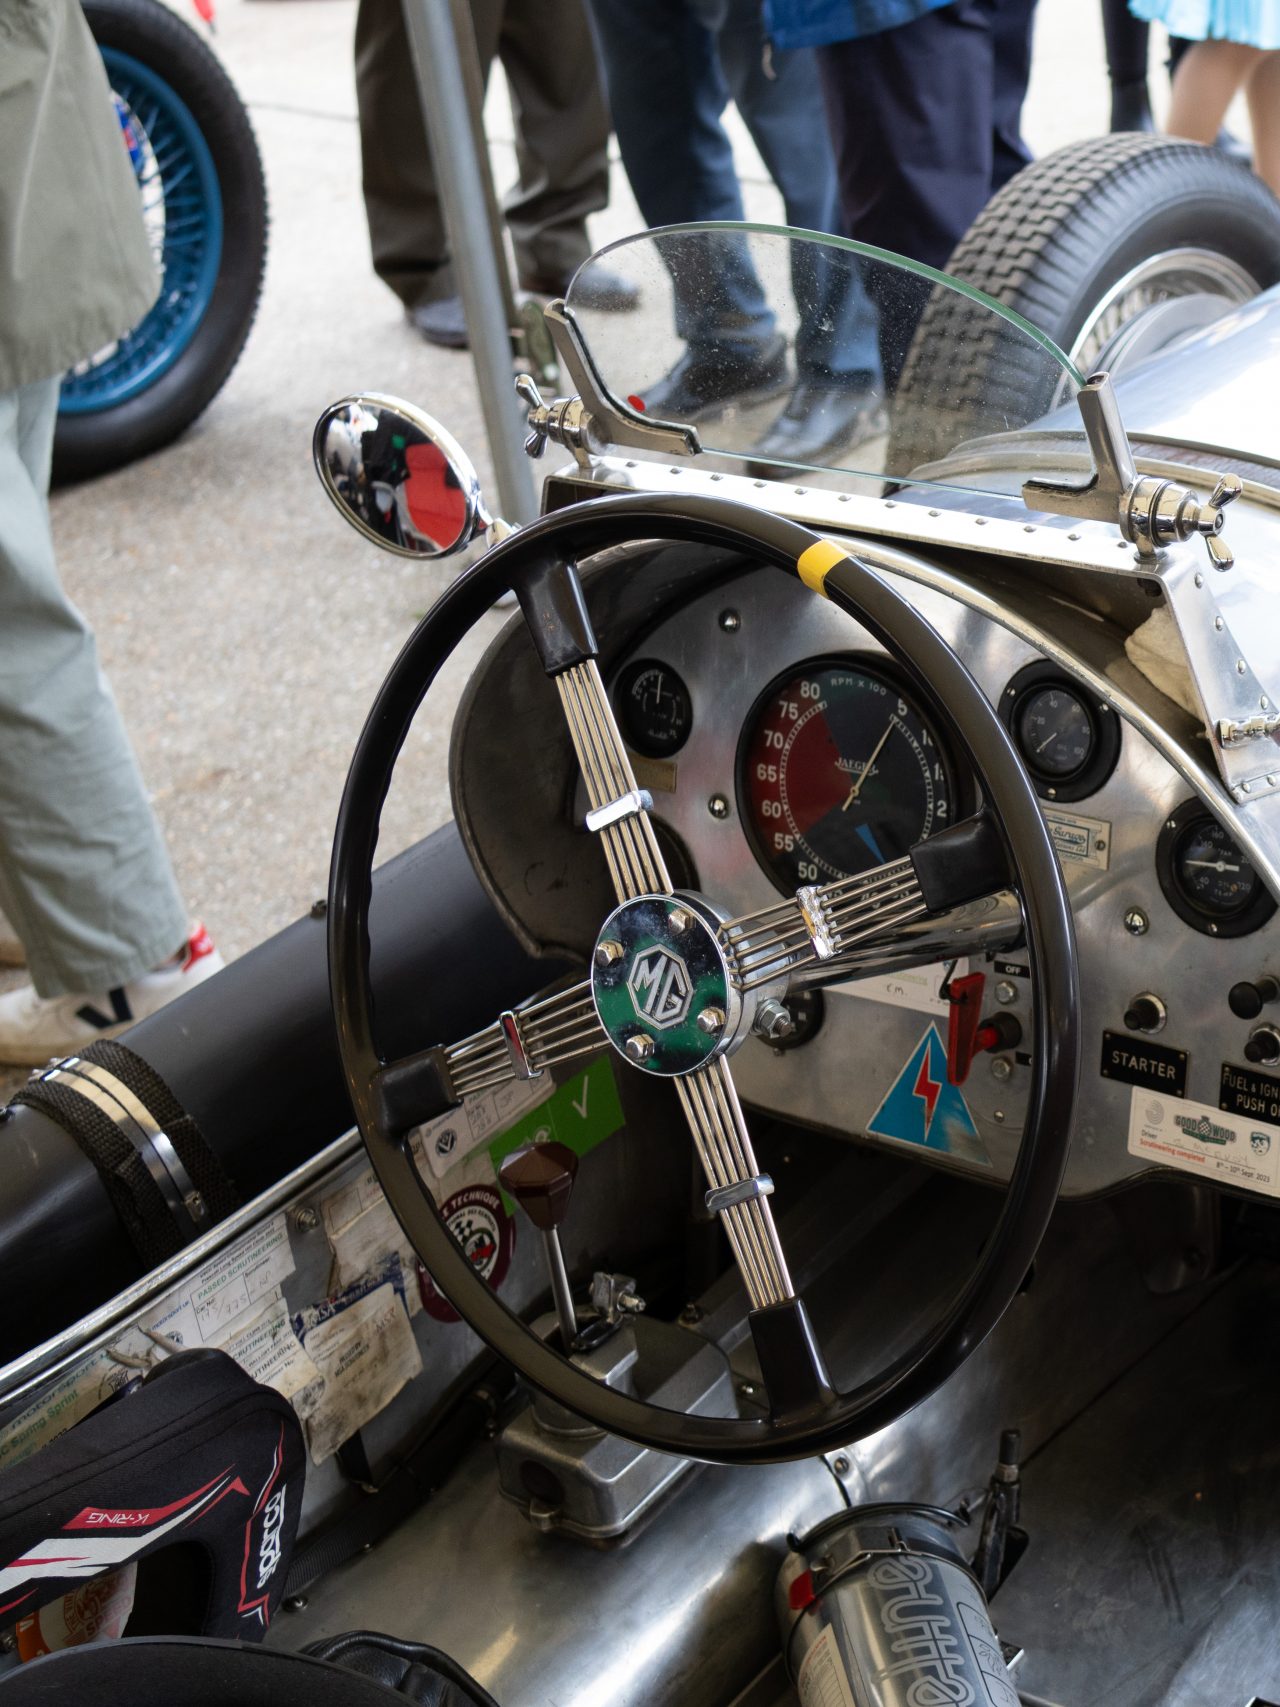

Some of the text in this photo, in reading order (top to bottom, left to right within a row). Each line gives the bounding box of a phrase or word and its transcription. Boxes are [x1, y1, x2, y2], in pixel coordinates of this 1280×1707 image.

[801, 681, 820, 700] 80
[831, 678, 853, 687] RPM
[869, 683, 886, 696] 100
[779, 701, 799, 720] 75
[898, 699, 908, 716] 5
[764, 730, 783, 749] 70
[757, 764, 777, 782] 65
[762, 801, 781, 819] 60
[774, 832, 794, 851] 55
[798, 861, 818, 880] 50
[1005, 965, 1021, 974] OFF
[631, 953, 687, 1021] MG
[1112, 1050, 1176, 1080] STARTER
[1223, 1072, 1247, 1092] FUEL
[1250, 1082, 1257, 1093] &
[1236, 1093, 1265, 1114] PUSH
[1141, 1129, 1158, 1140] Driver
[1176, 1147, 1206, 1163] completed
[1256, 1172, 1270, 1183] 2023
[451, 1190, 500, 1210] TECHNIQUE
[197, 1274, 227, 1300] PASSED
[233, 1318, 287, 1360] CRUTINEERING
[250, 1340, 297, 1379] UTINEERING
[11, 1417, 47, 1447] Spring
[47, 1389, 79, 1419] Sprint
[86, 1512, 149, 1524] K-RING
[256, 1484, 286, 1589] sparco
